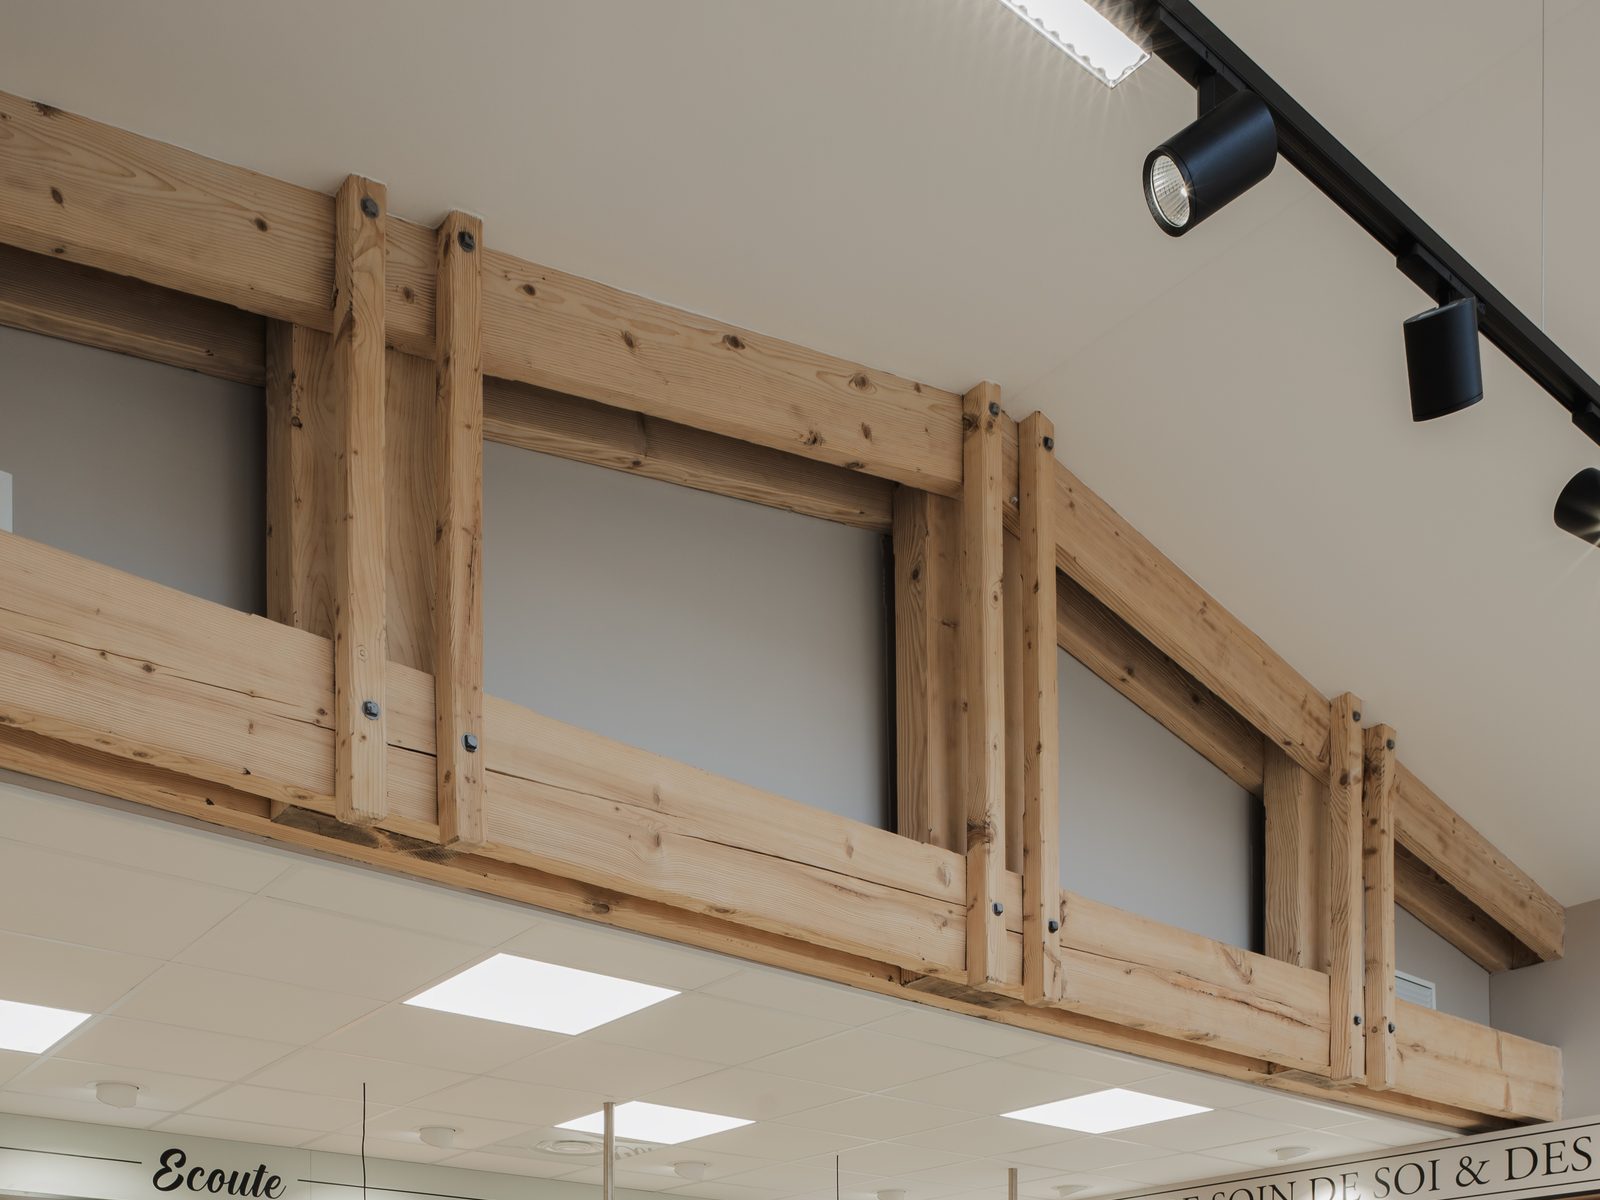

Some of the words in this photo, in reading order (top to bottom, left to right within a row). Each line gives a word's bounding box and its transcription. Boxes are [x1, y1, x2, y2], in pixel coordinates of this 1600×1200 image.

[153, 1148, 286, 1199] Ecoute
[1373, 1159, 1440, 1199] SOI
[1455, 1154, 1490, 1187] &
[1505, 1136, 1592, 1181] DES
